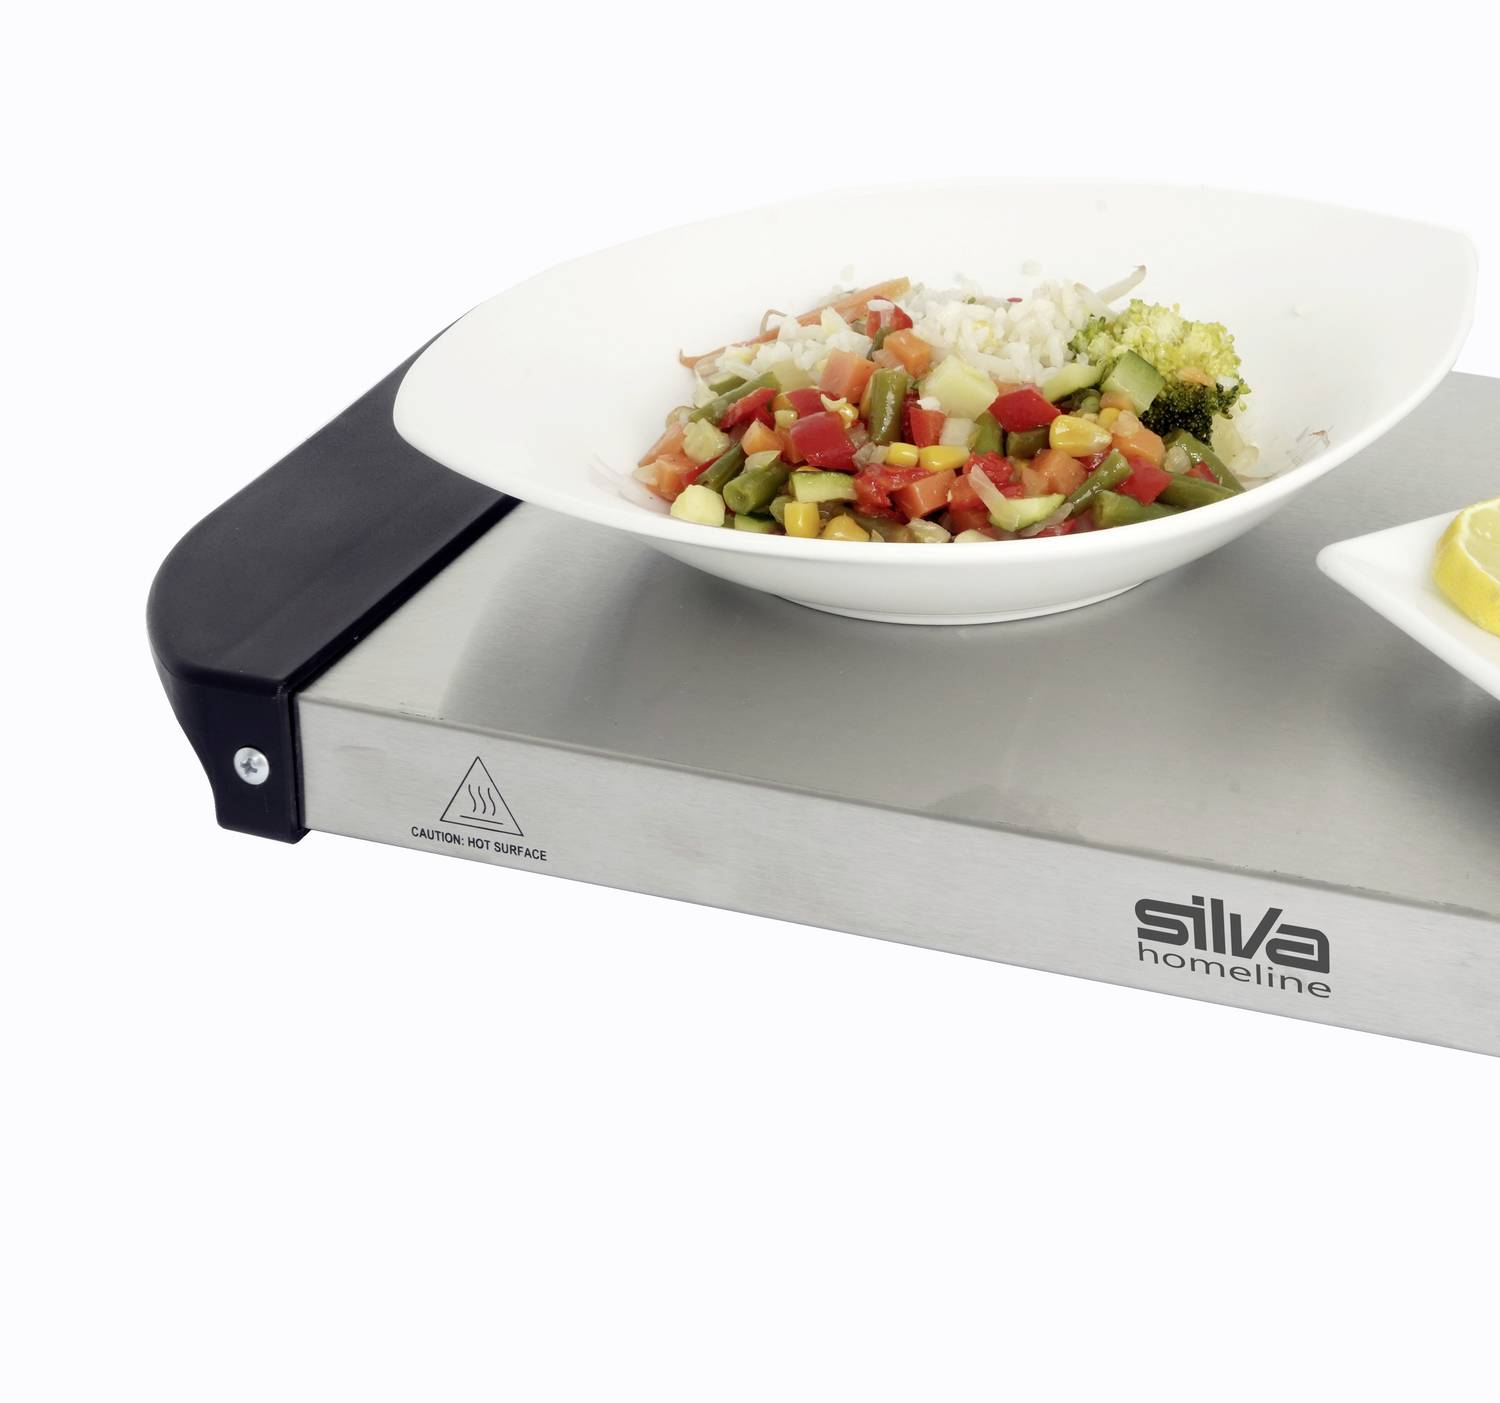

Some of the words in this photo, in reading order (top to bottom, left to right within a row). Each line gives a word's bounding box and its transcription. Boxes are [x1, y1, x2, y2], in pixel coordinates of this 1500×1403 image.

[411, 826, 464, 846] CAUTION:
[468, 837, 490, 850] HOT
[494, 842, 547, 861] SURFACE
[1135, 895, 1330, 974] silva
[1138, 942, 1332, 998] homeline
